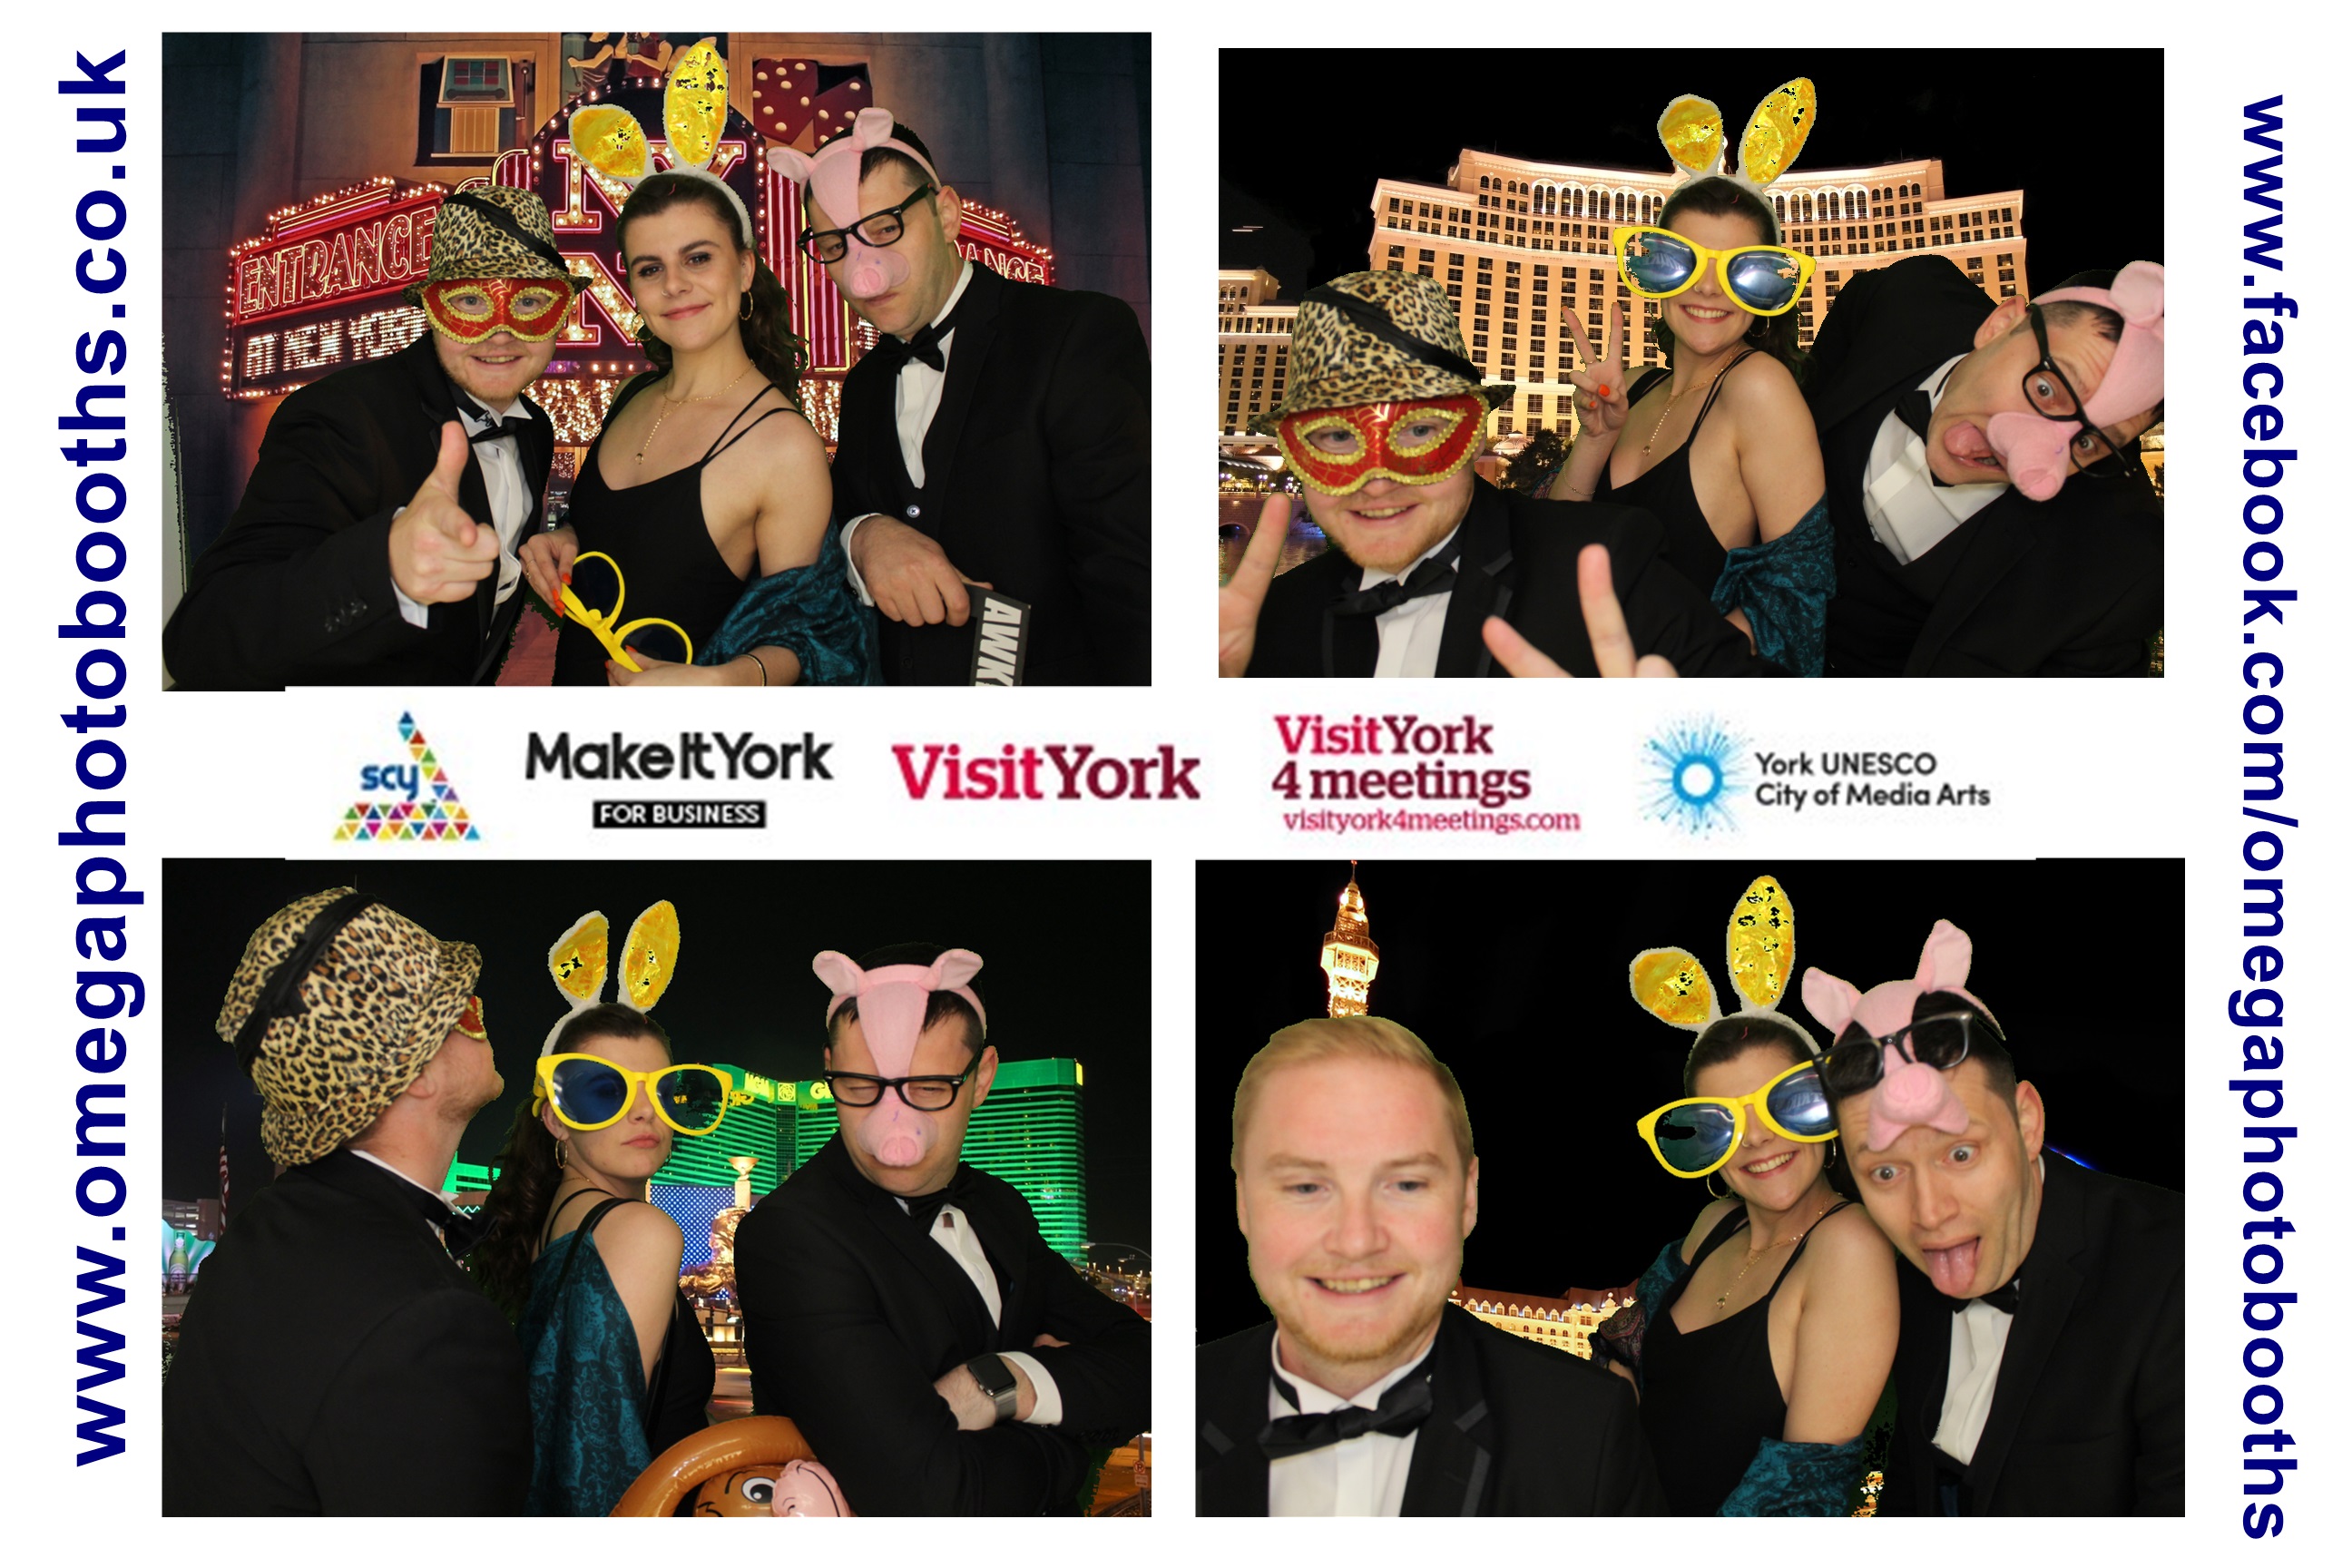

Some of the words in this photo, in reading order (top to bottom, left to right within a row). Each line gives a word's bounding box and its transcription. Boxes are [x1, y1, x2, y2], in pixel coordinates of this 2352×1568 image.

[240, 206, 437, 314] ENTRANCE
[246, 333, 280, 380] AT
[282, 318, 344, 372] NEW
[975, 597, 1022, 687] AWK
